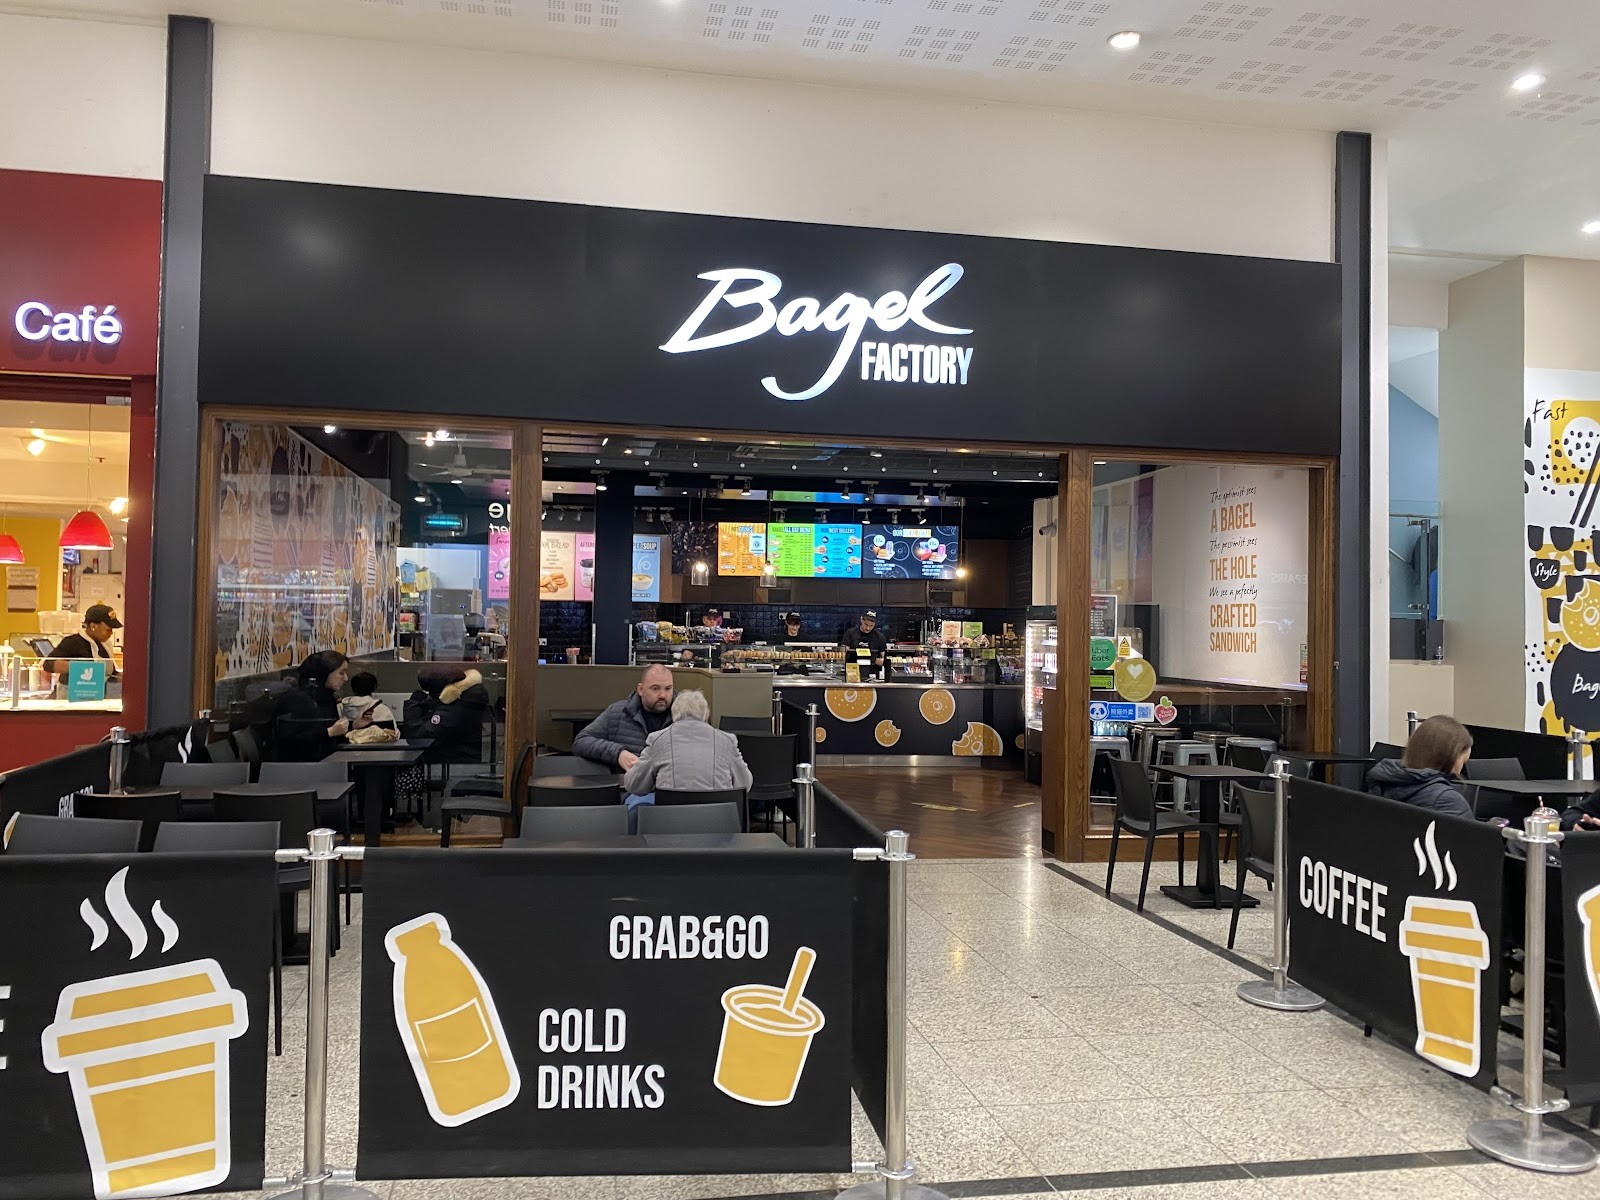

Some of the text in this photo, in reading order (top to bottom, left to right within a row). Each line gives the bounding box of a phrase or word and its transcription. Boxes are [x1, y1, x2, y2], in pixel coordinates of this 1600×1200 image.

[14, 301, 123, 345] Café
[658, 262, 974, 401] Bagel
[860, 341, 974, 385] FACTORY
[1532, 398, 1569, 424] Fast
[1210, 486, 1257, 504] The optimist sees
[1210, 502, 1257, 534] A BAGEL
[643, 542, 657, 550] SOUP
[1209, 537, 1258, 554] The pessimist sees
[1209, 554, 1257, 582] THE HOLE
[1534, 562, 1558, 582] Style
[1209, 586, 1219, 597] We
[1220, 588, 1228, 597] see
[1210, 603, 1257, 628] CRAFTED
[1091, 646, 1110, 655] Uber
[1209, 631, 1257, 653] SANDWICH
[1091, 654, 1110, 662] Eats
[1299, 855, 1388, 942] COFFEE
[609, 914, 770, 960] GRAB&GO
[538, 1007, 627, 1053] COLD
[537, 1063, 666, 1109] DRINKS
